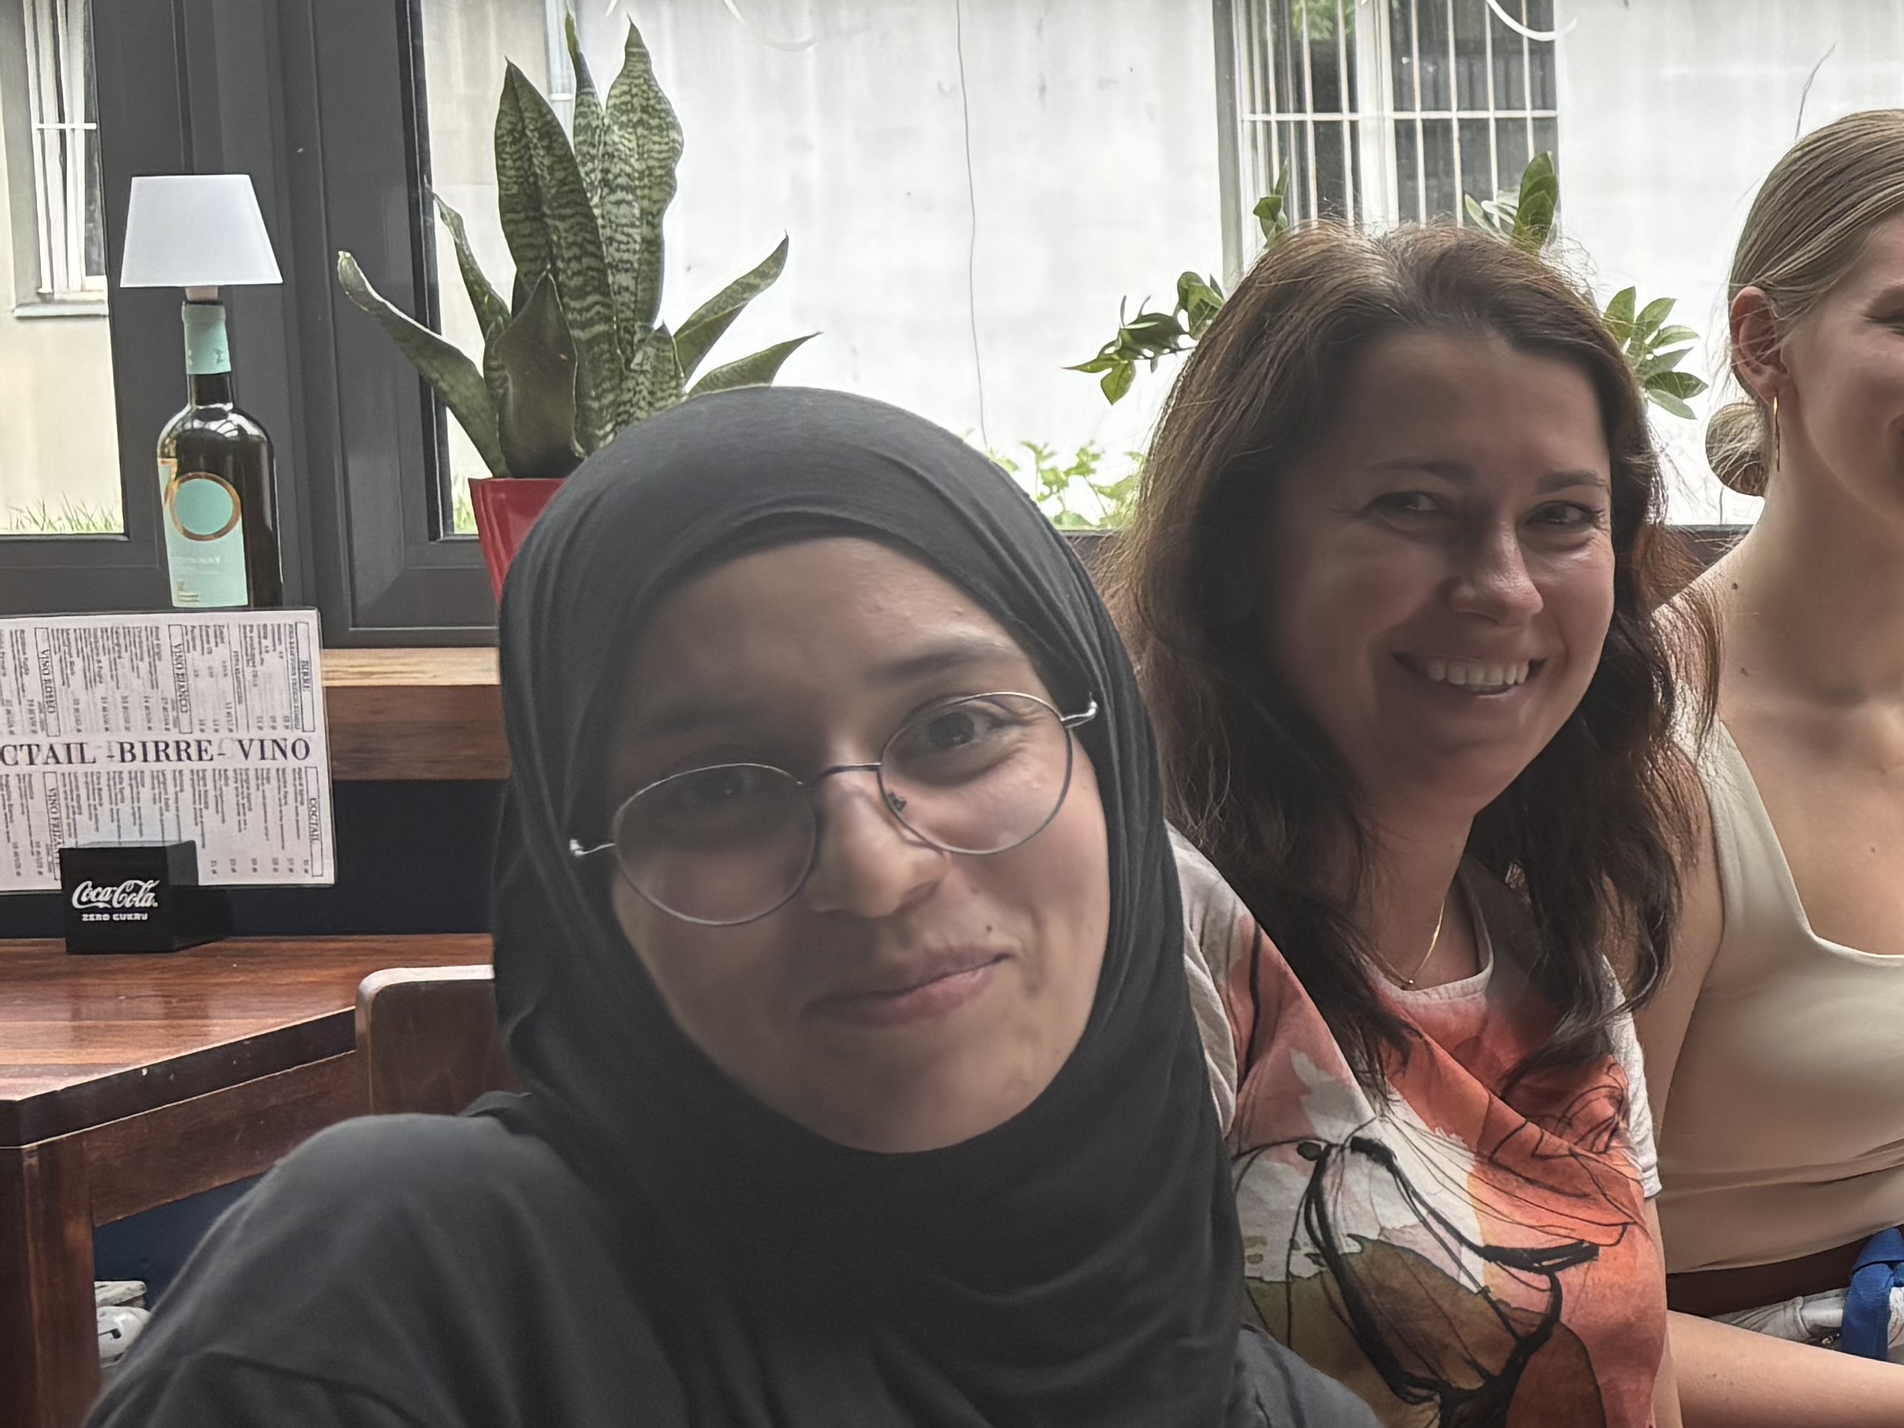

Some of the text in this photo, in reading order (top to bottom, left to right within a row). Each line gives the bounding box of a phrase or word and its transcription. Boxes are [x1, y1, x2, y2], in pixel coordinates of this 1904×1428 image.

[237, 738, 311, 761] VINO
[72, 879, 160, 909] Coca-Cola
[82, 913, 110, 922] ZERO
